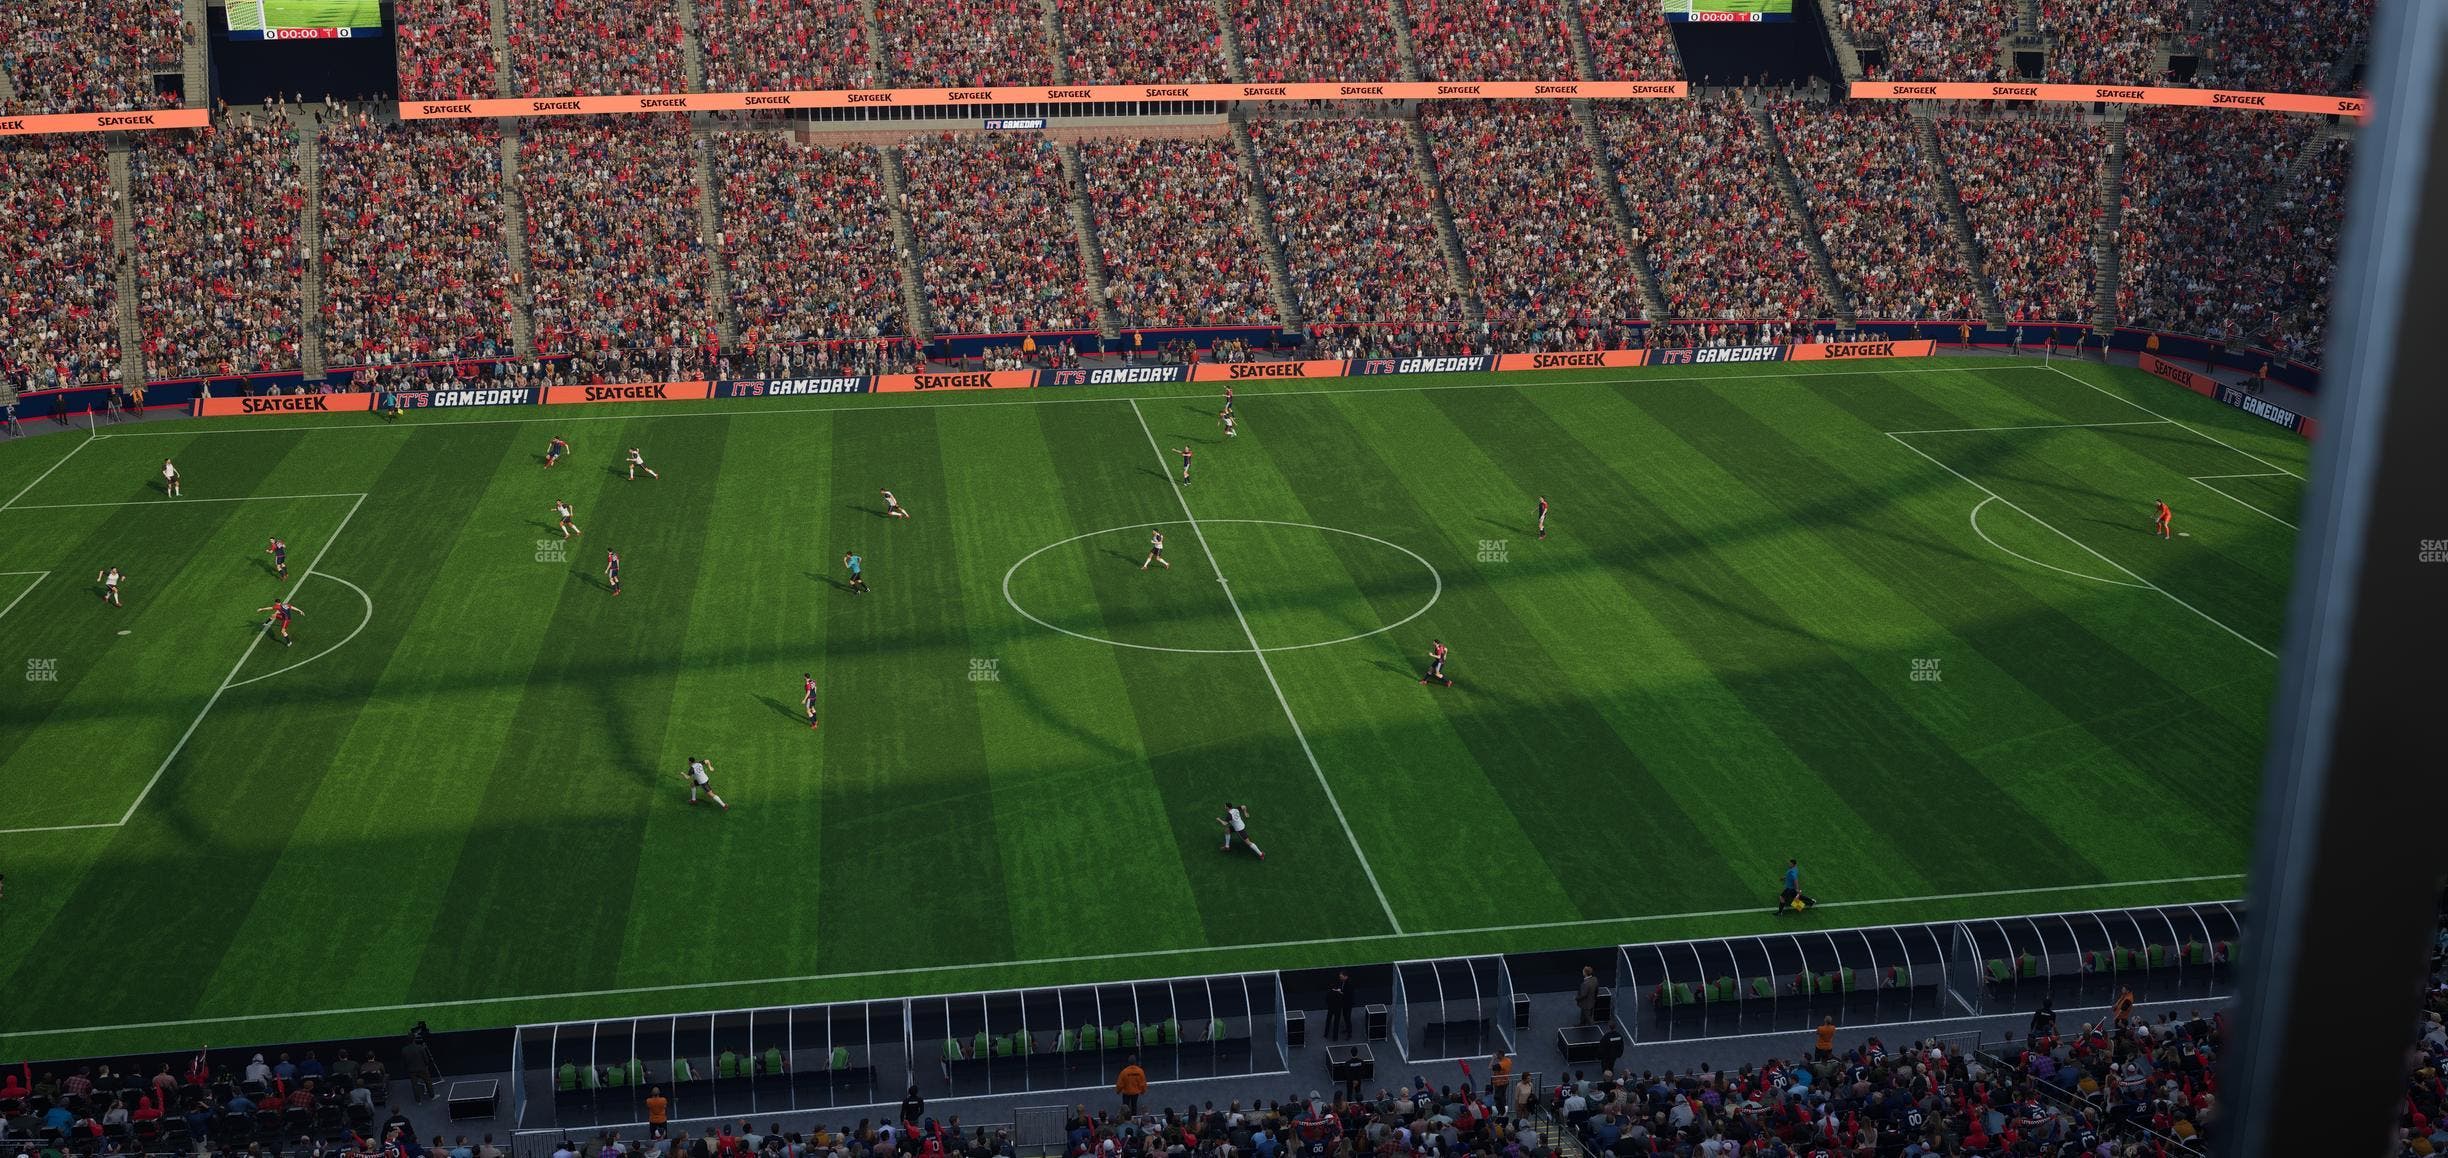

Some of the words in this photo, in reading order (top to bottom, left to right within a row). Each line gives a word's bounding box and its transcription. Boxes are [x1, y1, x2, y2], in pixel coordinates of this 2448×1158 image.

[1702, 13, 1734, 21] 00:00
[266, 30, 275, 38] 0
[280, 29, 318, 39] 00:00
[340, 28, 349, 37] 0
[1048, 89, 1092, 99] SEATGEEK
[1145, 88, 1189, 97] SEATGEEK
[1244, 87, 1287, 96] SEATGEEK
[1341, 86, 1384, 95] SEATGEEK
[1438, 85, 1480, 94] SEATGEEK
[1535, 85, 1578, 94] SEATGEEK
[1633, 86, 1675, 94] SEATGEEK
[1893, 86, 1936, 94] SEATGEEK
[1992, 86, 2037, 96] SEATGEEK
[2096, 89, 2144, 99] SEATGEEK
[745, 95, 791, 106] SEATGEEK
[847, 93, 892, 102] SEATGEEK
[948, 91, 993, 100] SEATGEEK
[2212, 93, 2265, 105] SEATGEEK
[533, 101, 581, 111] SEATGEEK
[640, 98, 687, 108] SEATGEEK
[423, 104, 472, 115] SEATGEEK
[0, 120, 24, 130] EEK
[98, 115, 154, 126] SEATGEEK
[1003, 120, 1042, 128] GAMEDAY!
[1662, 350, 1692, 364] IT'S
[1696, 347, 1777, 363] GAMEDAY!
[1825, 343, 1895, 358] SEATGEEK
[1364, 359, 1395, 375] IT'S
[1399, 356, 1484, 373] GAMEDAY!
[1533, 352, 1605, 368] SEATGEEK
[1054, 370, 1086, 385] IT'S
[1090, 367, 1178, 384] GAMEDAY!
[1230, 362, 1304, 379] SEATGEEK
[2153, 360, 2193, 387] SEATGEEK
[914, 372, 992, 390] SEATGEEK
[585, 384, 666, 401] SEATGEEK
[731, 381, 764, 396] IT'S
[769, 378, 860, 395] GAMEDAY!
[396, 392, 429, 408] IT'S
[434, 389, 529, 407] GAMEDAY!
[242, 396, 328, 413] SEATGEEK
[2242, 396, 2295, 429] GAMEDAY!
[1774, 1076, 1788, 1088] 00
[1908, 1113, 1922, 1126] 00
[1312, 1145, 1324, 1153] 00
